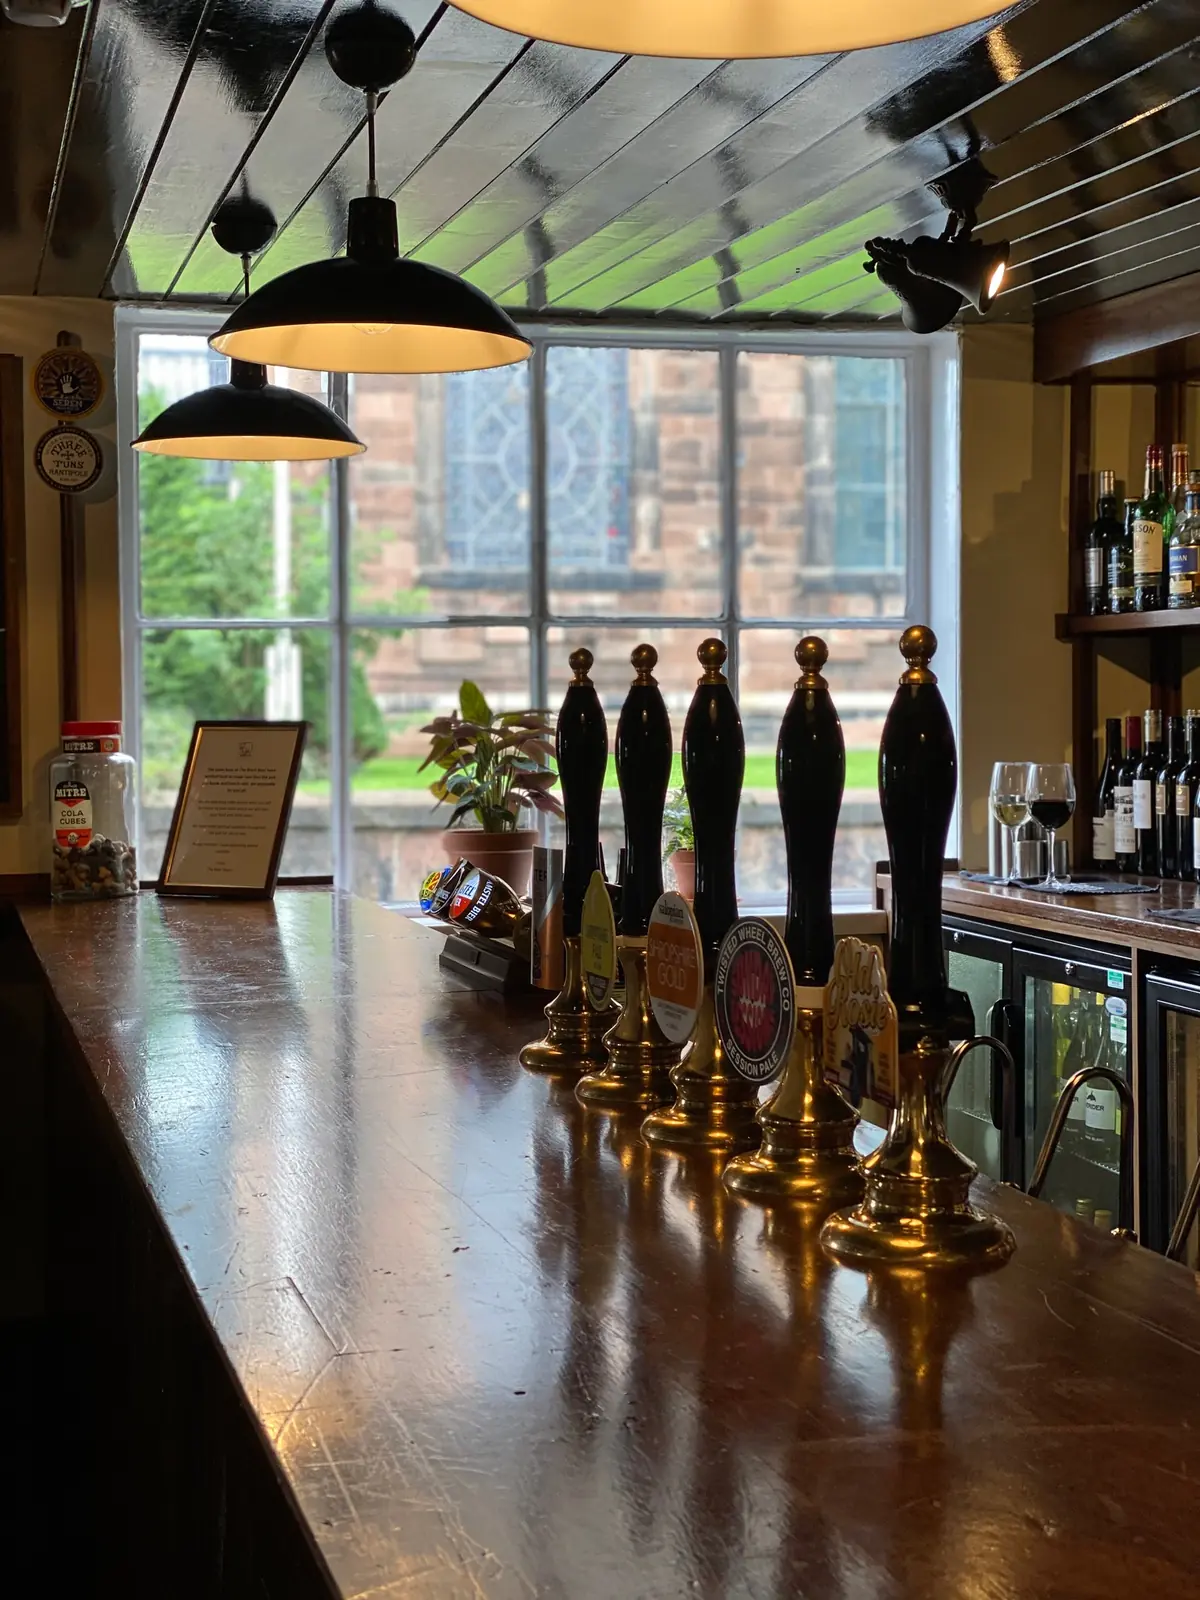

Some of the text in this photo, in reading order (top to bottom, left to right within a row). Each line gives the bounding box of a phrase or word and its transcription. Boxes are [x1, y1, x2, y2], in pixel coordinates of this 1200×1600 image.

[50, 440, 87, 457] THREE
[53, 460, 85, 468] TUNS
[64, 741, 94, 751] MITRE
[55, 788, 87, 798] MITRE
[59, 817, 88, 825] CUBES
[465, 879, 495, 922] AMSTEL BIER
[649, 938, 697, 968] SHROPSHIRE
[657, 962, 687, 991] GOLD
[717, 928, 789, 1012] TWISTED WHEEL BREW CO
[834, 941, 878, 996] Old
[827, 977, 889, 1031] Rosie
[726, 1039, 779, 1077] SESSION PALE
